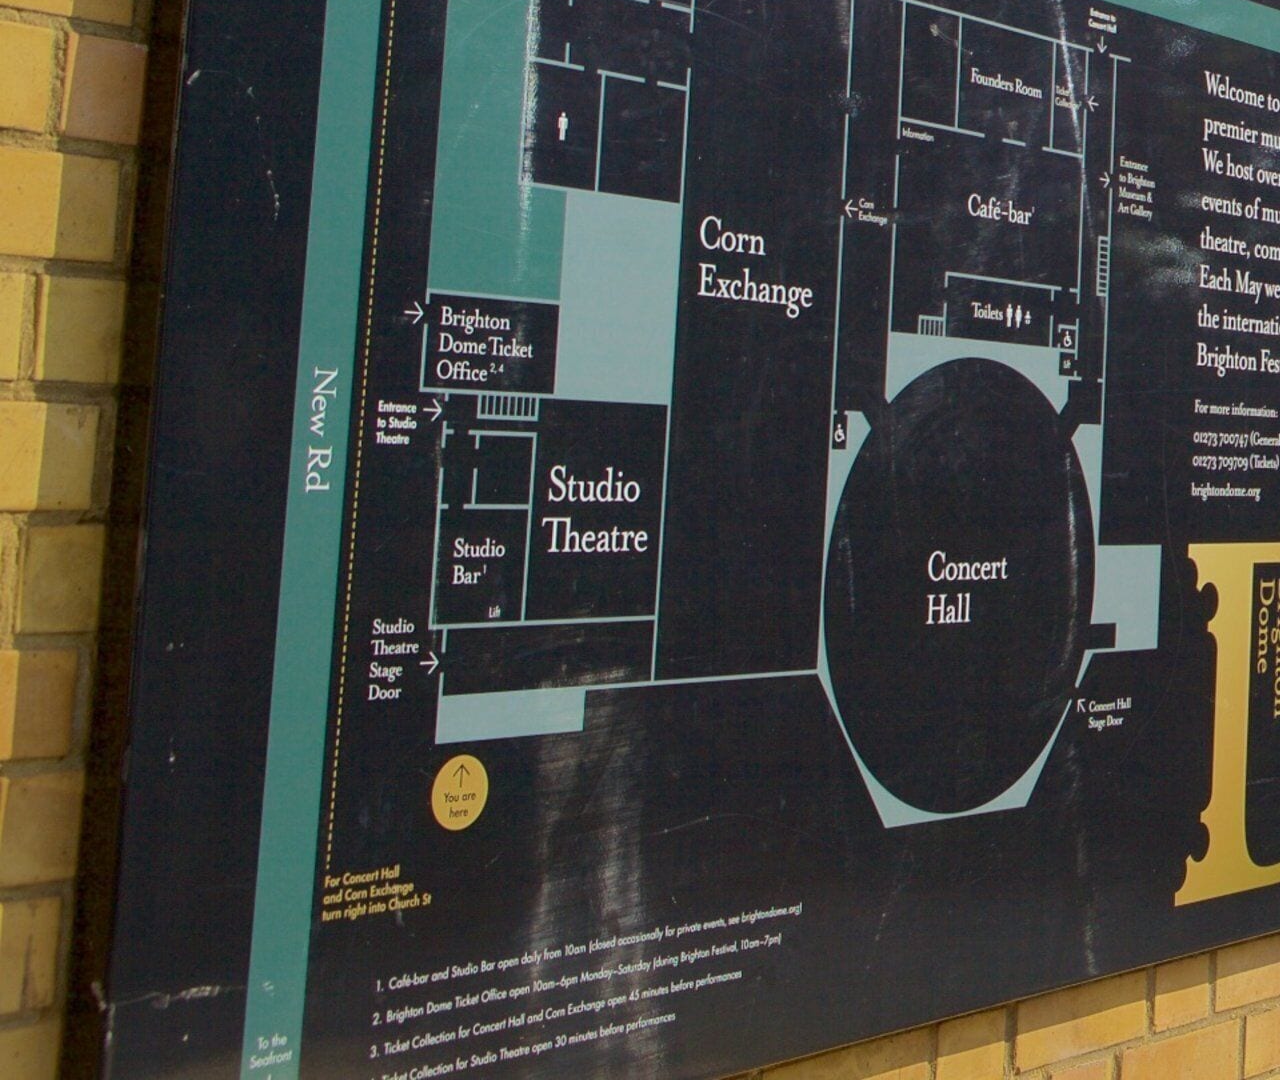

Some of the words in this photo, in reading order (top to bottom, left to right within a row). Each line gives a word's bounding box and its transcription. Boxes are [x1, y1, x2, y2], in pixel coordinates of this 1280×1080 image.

[970, 67, 1014, 93] Founders
[1015, 78, 1042, 99] Room
[1204, 70, 1265, 109] Welcome
[1267, 93, 1280, 112] to
[902, 127, 935, 142] Information
[1203, 117, 1258, 144] premier
[1202, 147, 1223, 174] We
[1226, 153, 1254, 181] host
[1201, 194, 1242, 218] events
[1244, 196, 1261, 219] of
[700, 215, 766, 256] Corn
[1200, 226, 1251, 259] theatre,
[697, 262, 813, 319] Exchange
[1200, 264, 1232, 292] Each
[1235, 269, 1262, 304] May
[1264, 283, 1280, 299] we
[440, 305, 511, 335] Brighton
[971, 301, 1003, 321] Toilets
[1197, 303, 1220, 329] the
[438, 332, 486, 355] Dome
[488, 336, 534, 359] Ticket
[1196, 342, 1257, 377] Brighton
[309, 366, 339, 438] New
[378, 400, 417, 414] Entrance
[1194, 399, 1208, 414] For
[1210, 403, 1230, 416] more
[1232, 402, 1278, 418] information:
[377, 417, 386, 428] to
[388, 416, 417, 430] Studio
[376, 432, 410, 445] Theatre
[1193, 431, 1217, 447] 01273
[1219, 432, 1248, 449] 700747
[1250, 429, 1280, 447] (General
[305, 445, 333, 493] Rd
[1192, 455, 1217, 470] 01273
[1218, 455, 1248, 471] 709709
[1250, 453, 1280, 471] (Tickets)
[548, 464, 640, 503] Studio
[1191, 482, 1261, 502] brightondome.org
[453, 537, 505, 558] Studio
[541, 517, 648, 553] Theatre
[928, 550, 1008, 582] Concert
[925, 592, 971, 625] Hall
[372, 618, 414, 635] Studio
[1257, 578, 1275, 675] Dome
[370, 639, 420, 656] Theatre
[369, 662, 403, 682] Stage
[368, 684, 402, 701] Door
[443, 791, 459, 804] You
[462, 791, 476, 802] are
[449, 806, 468, 818] here
[324, 875, 341, 889] For
[342, 870, 380, 885] Concert
[381, 864, 401, 879] Hall
[323, 889, 342, 905] and
[344, 888, 368, 901] Corn
[370, 881, 414, 897] Exchange
[322, 909, 342, 922] turn
[343, 902, 367, 921] right
[368, 901, 386, 914] into
[388, 894, 420, 911] Church
[422, 892, 432, 906] St
[376, 979, 384, 992] 1.
[388, 973, 429, 990] Café-bar
[431, 967, 449, 983] and
[451, 963, 479, 979] Studio
[480, 960, 496, 973] Bar
[497, 957, 520, 971] open
[521, 951, 541, 966] daily
[543, 947, 562, 961] from
[564, 944, 586, 957] 10am
[589, 936, 616, 955] (closed
[618, 927, 664, 946] occasionally
[665, 925, 676, 937] for
[677, 922, 701, 937] private
[728, 913, 740, 925] see
[372, 1012, 382, 1026] 2.
[386, 1004, 424, 1024] Brighton
[426, 999, 452, 1015] Dome
[455, 993, 479, 1009] Ticket
[481, 988, 507, 1003] Office
[509, 985, 530, 1000] open
[653, 955, 679, 970] (during
[680, 949, 710, 964] Brighton
[711, 941, 738, 956] Festival,
[370, 1045, 379, 1058] 3.
[384, 1040, 410, 1056] Ticket
[411, 1031, 455, 1050] Collection
[458, 1025, 470, 1038] for
[472, 1020, 506, 1036] Concert
[508, 1014, 525, 1029] Hall
[527, 1009, 543, 1024] and
[545, 1006, 565, 1020] Corn
[567, 998, 605, 1015] Exchange
[607, 994, 627, 1008] open
[628, 989, 640, 1001] 45
[641, 985, 669, 1000] minutes
[670, 980, 695, 993] before
[695, 971, 742, 990] performances
[258, 1036, 269, 1050] To
[271, 1032, 288, 1047] the
[249, 1050, 292, 1069] Seafront
